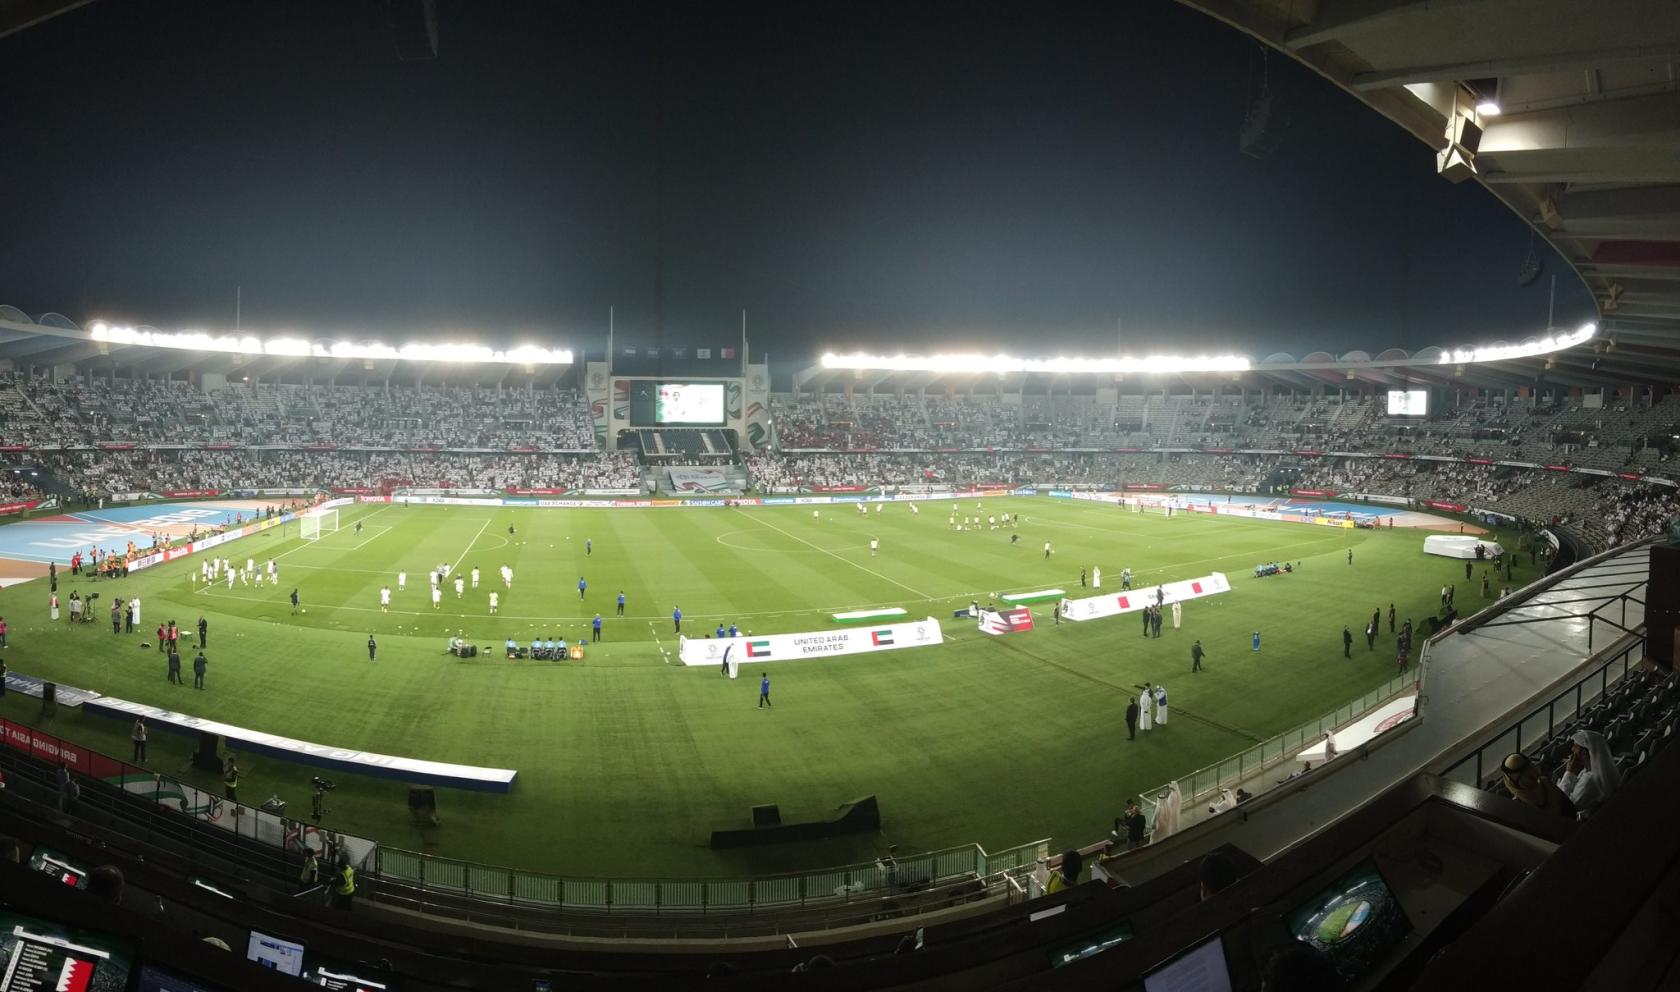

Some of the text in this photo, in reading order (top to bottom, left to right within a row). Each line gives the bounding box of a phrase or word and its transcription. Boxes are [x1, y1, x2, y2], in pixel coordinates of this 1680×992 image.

[794, 634, 849, 646] UNITED ARAB
[803, 643, 844, 654] EMIRATES
